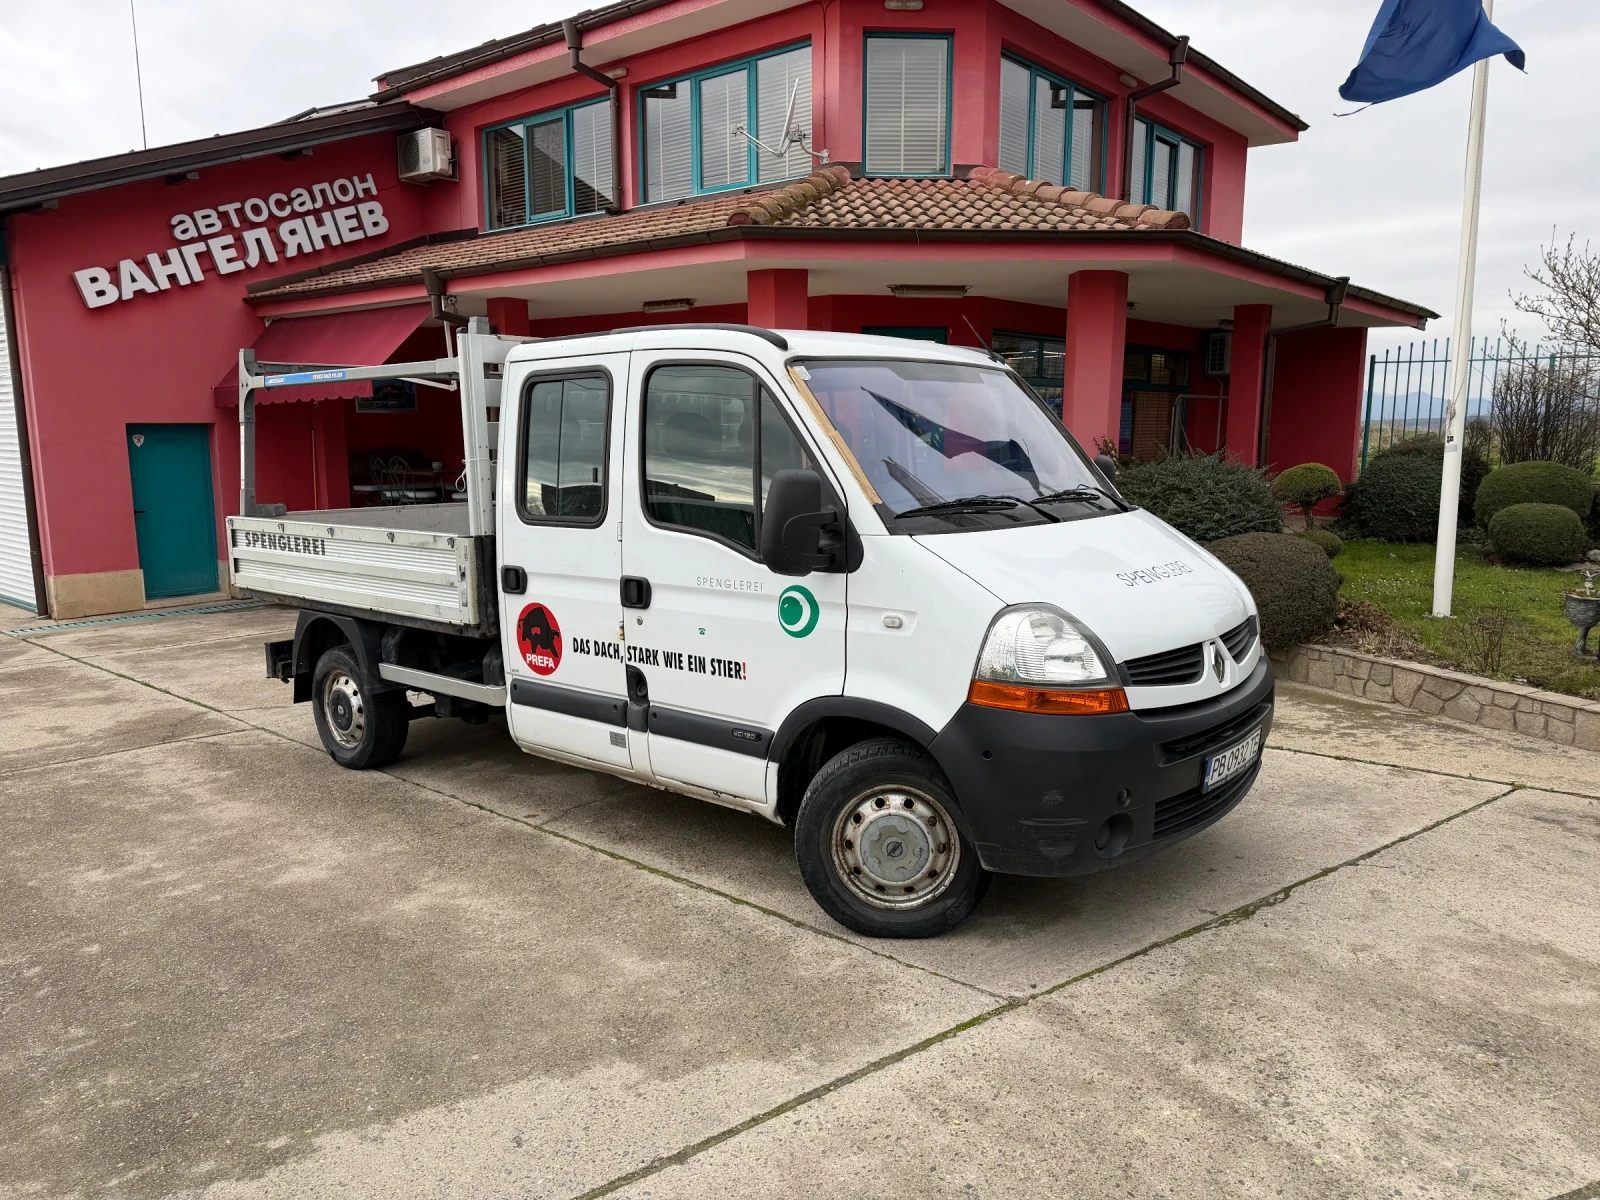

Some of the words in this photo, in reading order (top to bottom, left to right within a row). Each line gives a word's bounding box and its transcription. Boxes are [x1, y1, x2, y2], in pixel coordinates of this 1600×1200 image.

[170, 172, 378, 241] автосалон
[72, 226, 279, 309] ВАНГЕЛ
[277, 201, 390, 259] ЯНЕВ
[245, 531, 326, 556] SPENGLEREI
[696, 576, 764, 592] SPENGLEREI
[1116, 560, 1194, 587] SPENGLEREI
[525, 653, 556, 670] PREFA
[572, 637, 591, 655] DAS
[594, 640, 624, 664] DACH,
[626, 645, 659, 667] STARK
[662, 651, 683, 671] WIE
[687, 654, 706, 675] EIN
[710, 658, 747, 681] STIER!
